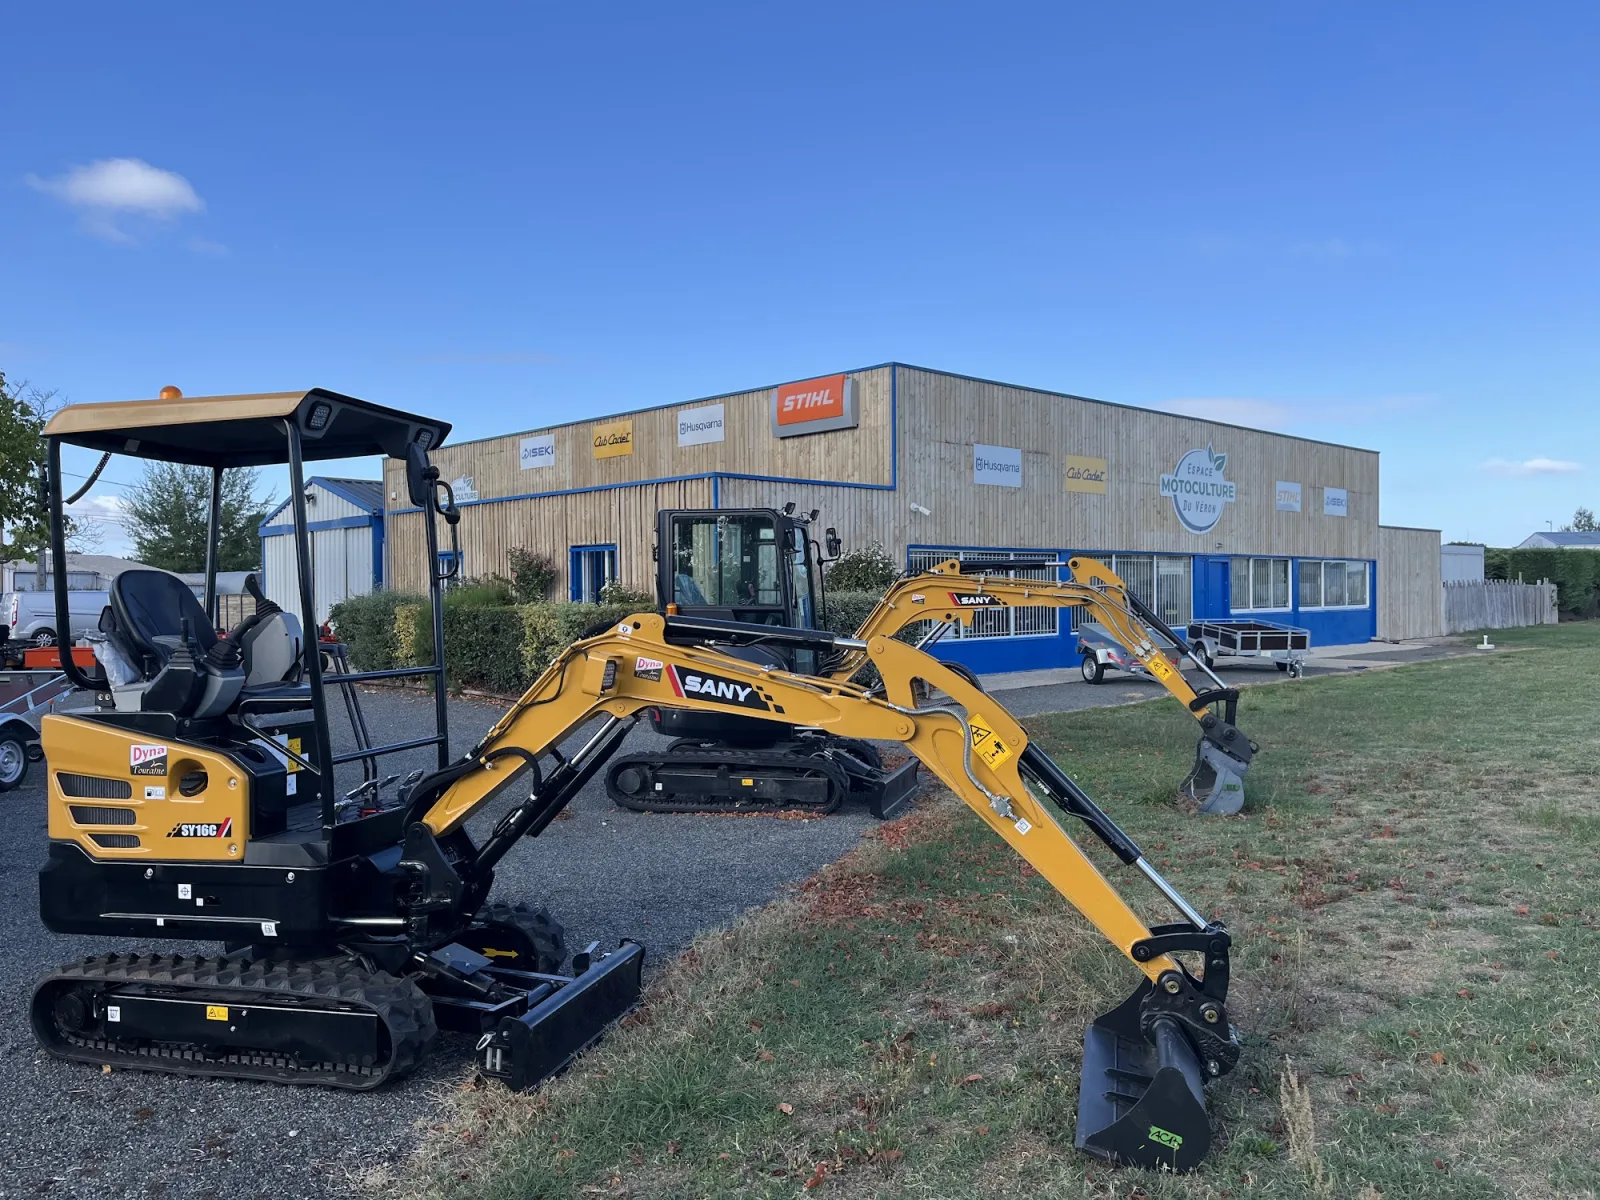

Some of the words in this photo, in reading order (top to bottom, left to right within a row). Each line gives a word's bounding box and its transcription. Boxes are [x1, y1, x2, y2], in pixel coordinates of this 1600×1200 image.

[783, 389, 834, 412] STIHL
[686, 419, 722, 433] Husqvarna
[594, 435, 607, 448] Cub
[608, 432, 632, 446] Cadet
[529, 445, 554, 458] ISEKI
[983, 459, 1020, 474] Husqvarna
[1187, 463, 1213, 477] ESPACE
[1066, 466, 1081, 480] Cub
[1082, 468, 1106, 482] Cadet
[1161, 477, 1234, 499] MOTOCULTURE
[1277, 490, 1300, 504] STIHL
[960, 596, 991, 605] SANY
[636, 657, 662, 670] Dyna
[684, 675, 752, 702] SANY
[133, 746, 165, 762] Dyna
[132, 765, 165, 775] Touraine
[181, 824, 217, 837] SY16C
